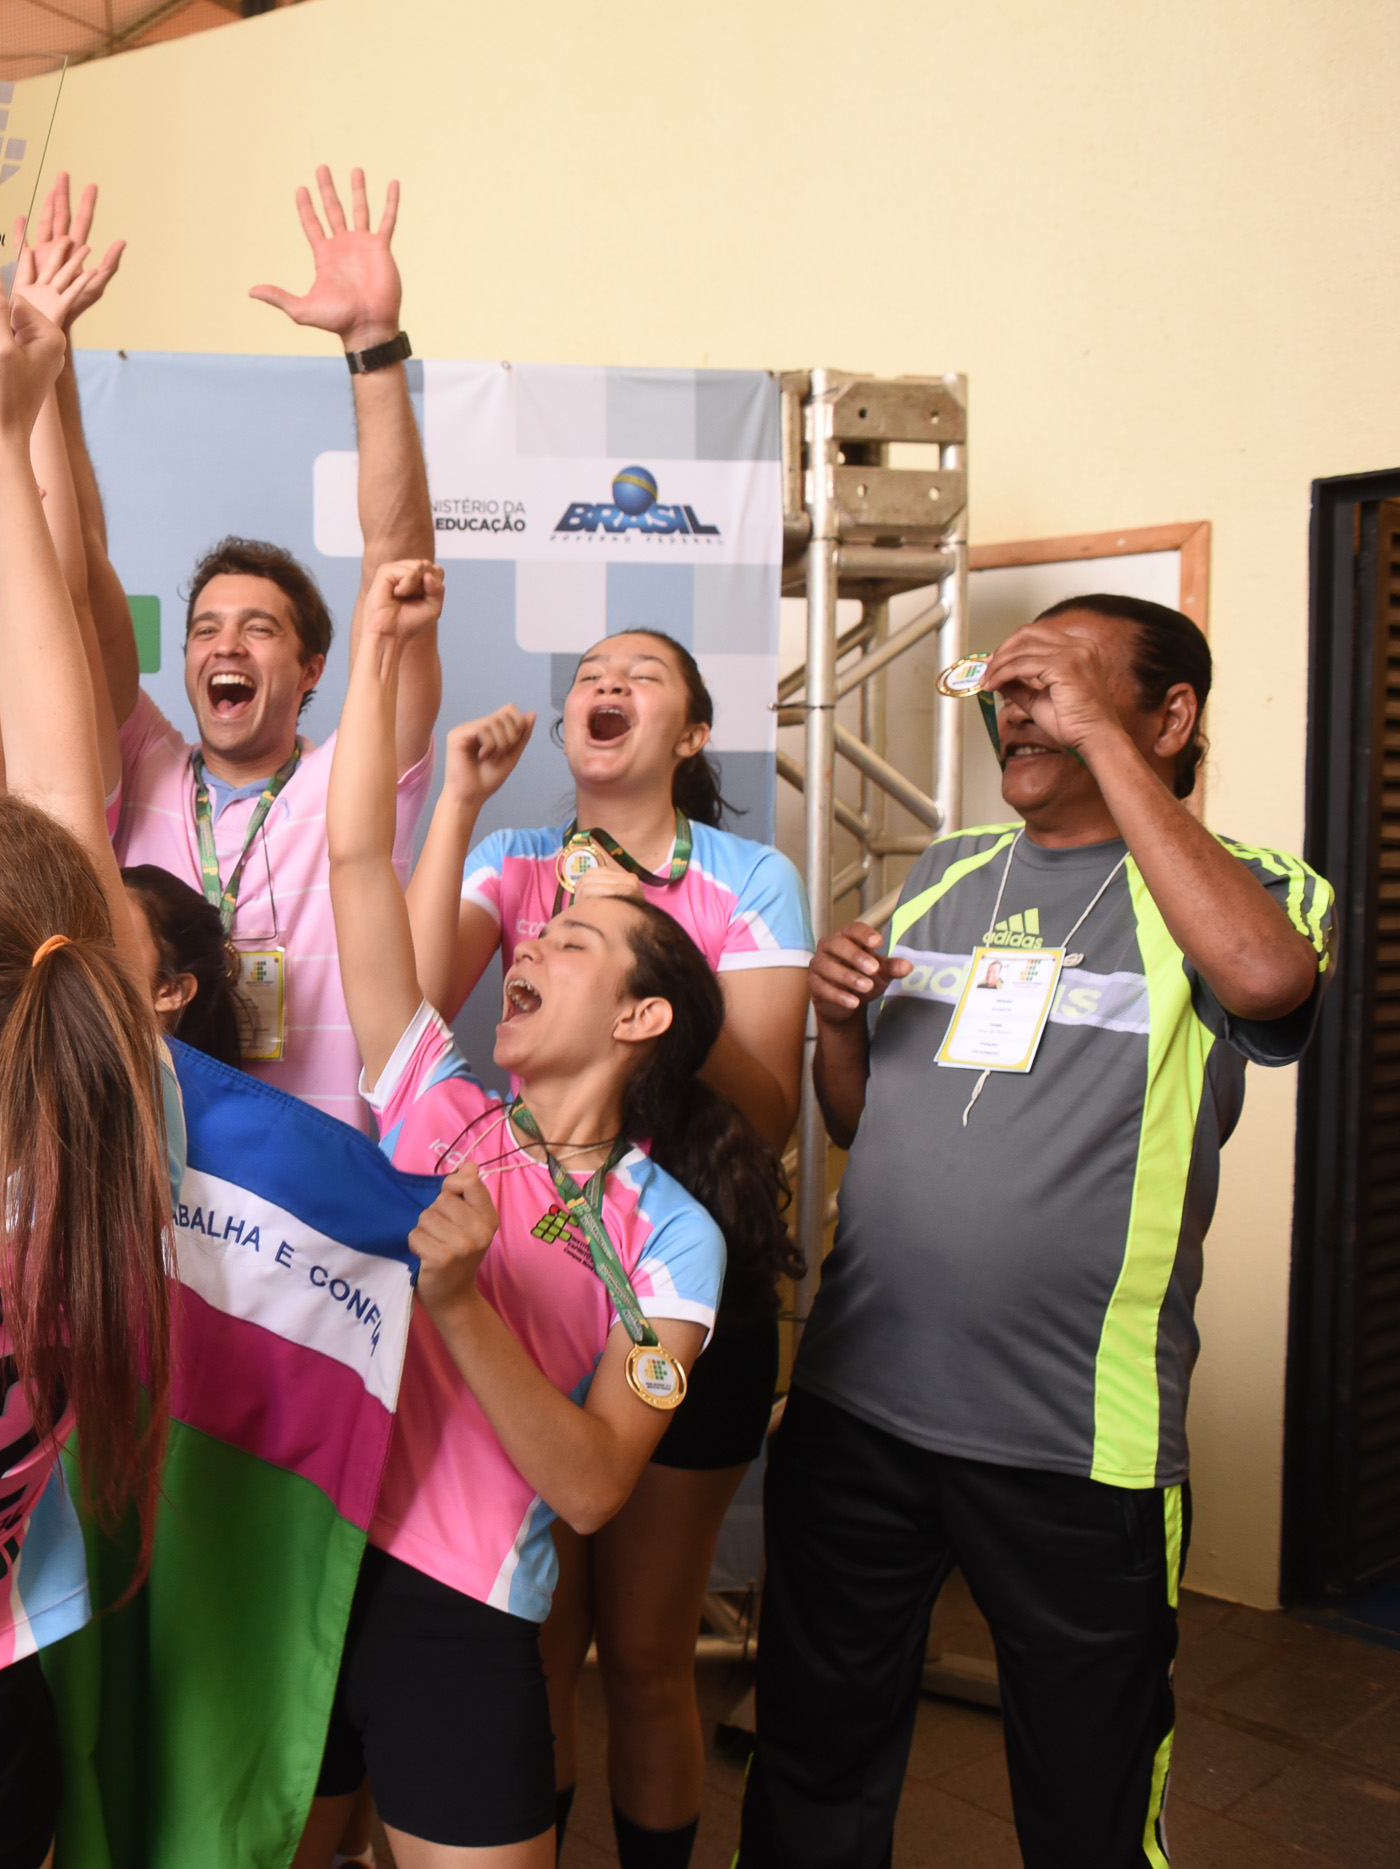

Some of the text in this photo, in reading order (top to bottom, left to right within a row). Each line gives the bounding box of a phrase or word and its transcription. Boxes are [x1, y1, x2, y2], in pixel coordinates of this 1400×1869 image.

[431, 497, 526, 514] NISTÉRIO DA
[435, 515, 526, 533] EDUCAÇÃO
[554, 502, 721, 535] BRASIL
[982, 930, 1044, 949] adidas
[172, 1203, 260, 1252] BALHA
[274, 1240, 296, 1269] E
